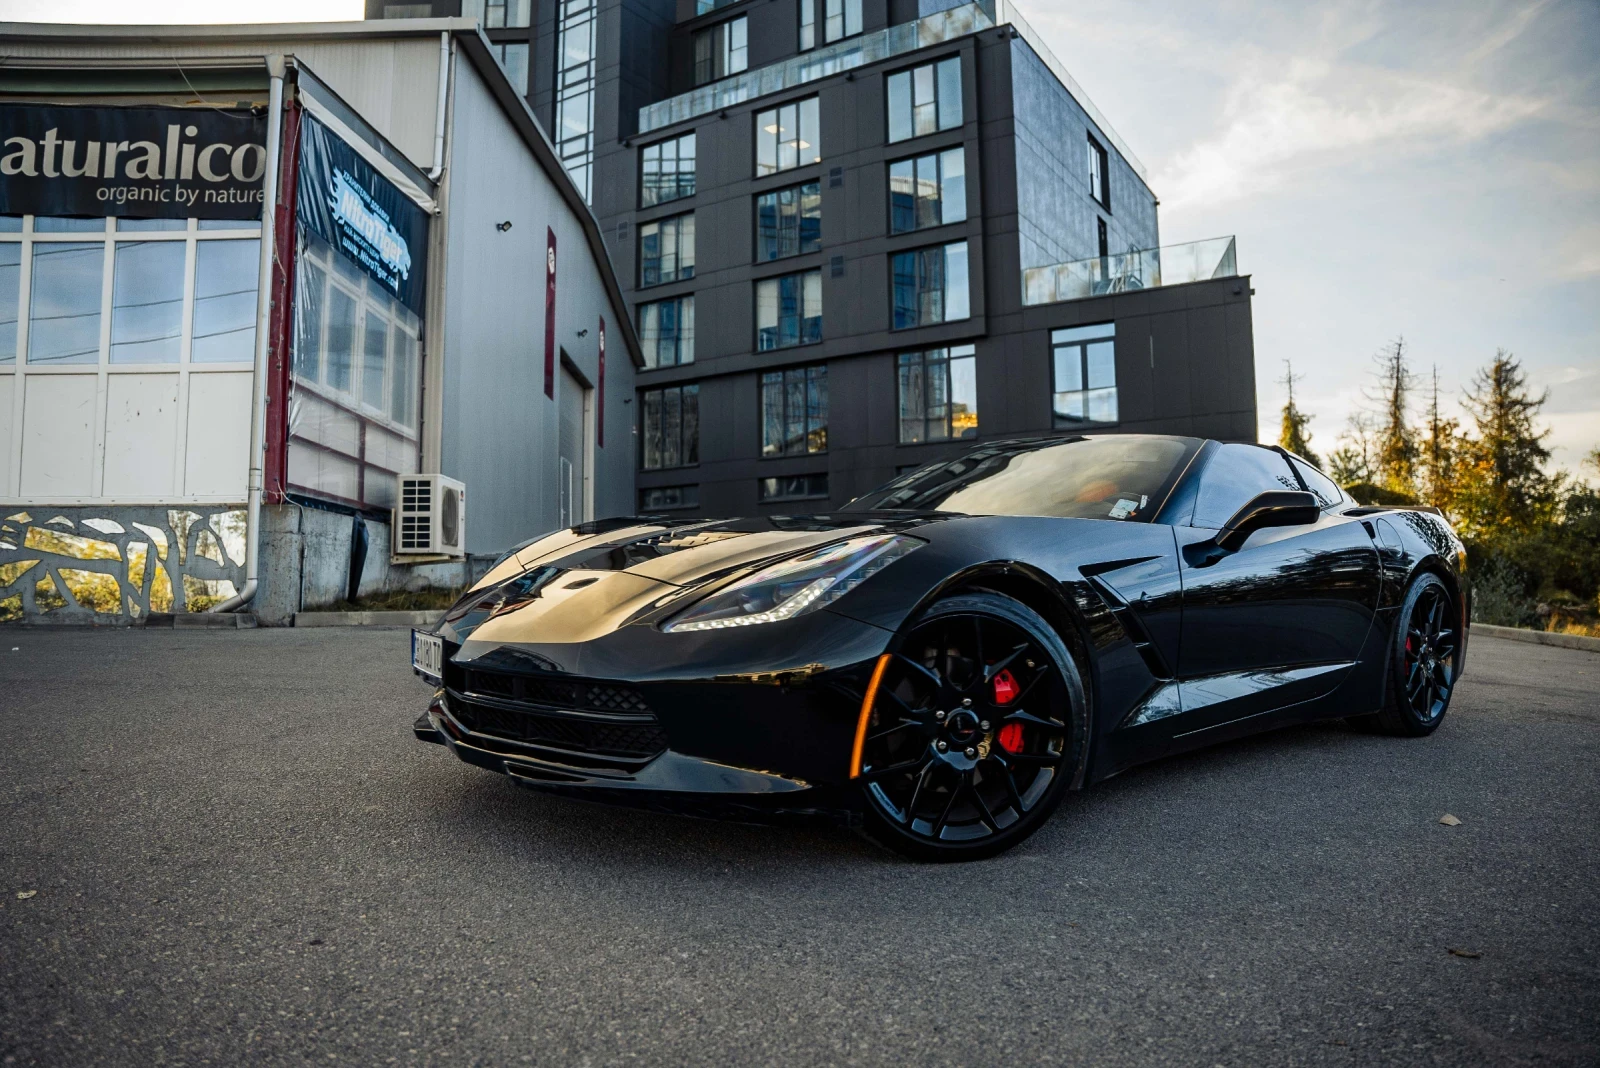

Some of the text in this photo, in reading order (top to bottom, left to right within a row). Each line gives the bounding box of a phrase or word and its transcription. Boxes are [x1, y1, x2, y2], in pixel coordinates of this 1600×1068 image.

[0, 124, 267, 183] aturalico
[96, 184, 265, 207] organic by nature
[341, 189, 403, 265] NitroTiger
